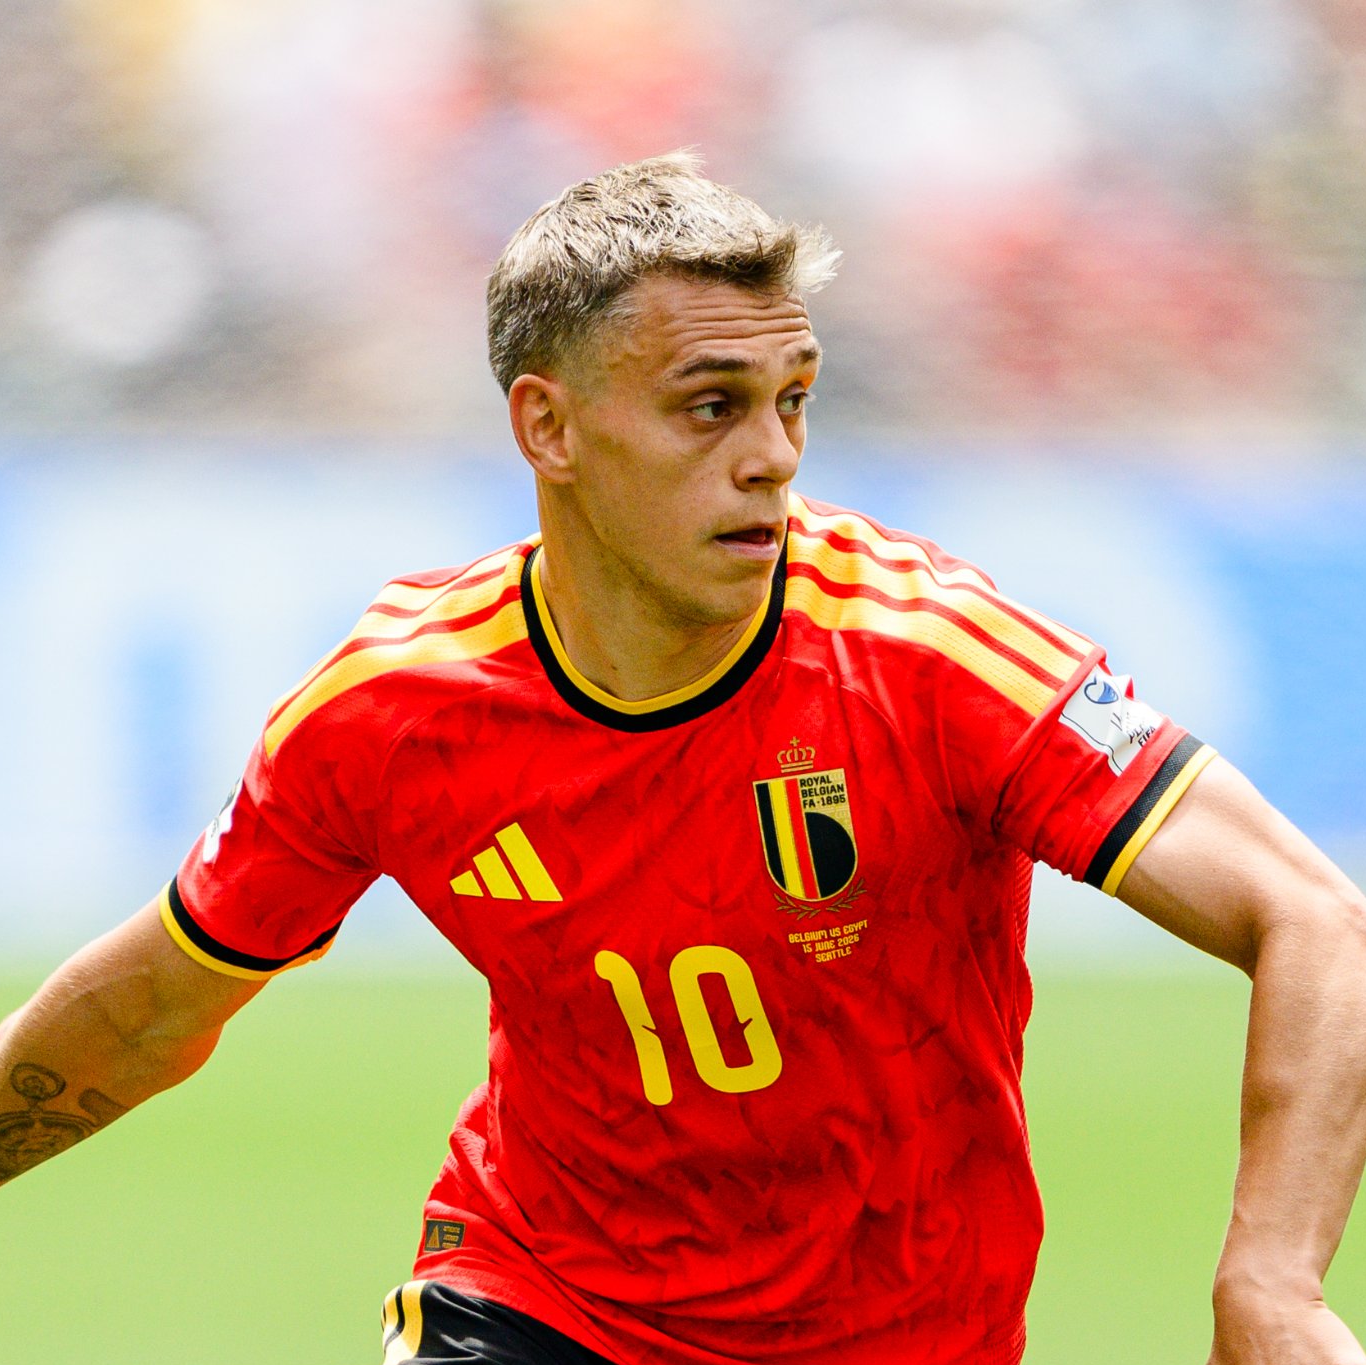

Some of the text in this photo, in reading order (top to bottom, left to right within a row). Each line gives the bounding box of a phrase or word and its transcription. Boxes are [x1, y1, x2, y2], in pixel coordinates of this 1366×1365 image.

[799, 775, 832, 788] ROYAL
[801, 783, 845, 798] BELGIAN
[788, 930, 828, 944] BELGIUM
[842, 919, 868, 935] EGYPT
[802, 933, 860, 954] 15 JUNE 2026
[815, 946, 852, 963] SEATTLE
[594, 945, 783, 1106] 10
